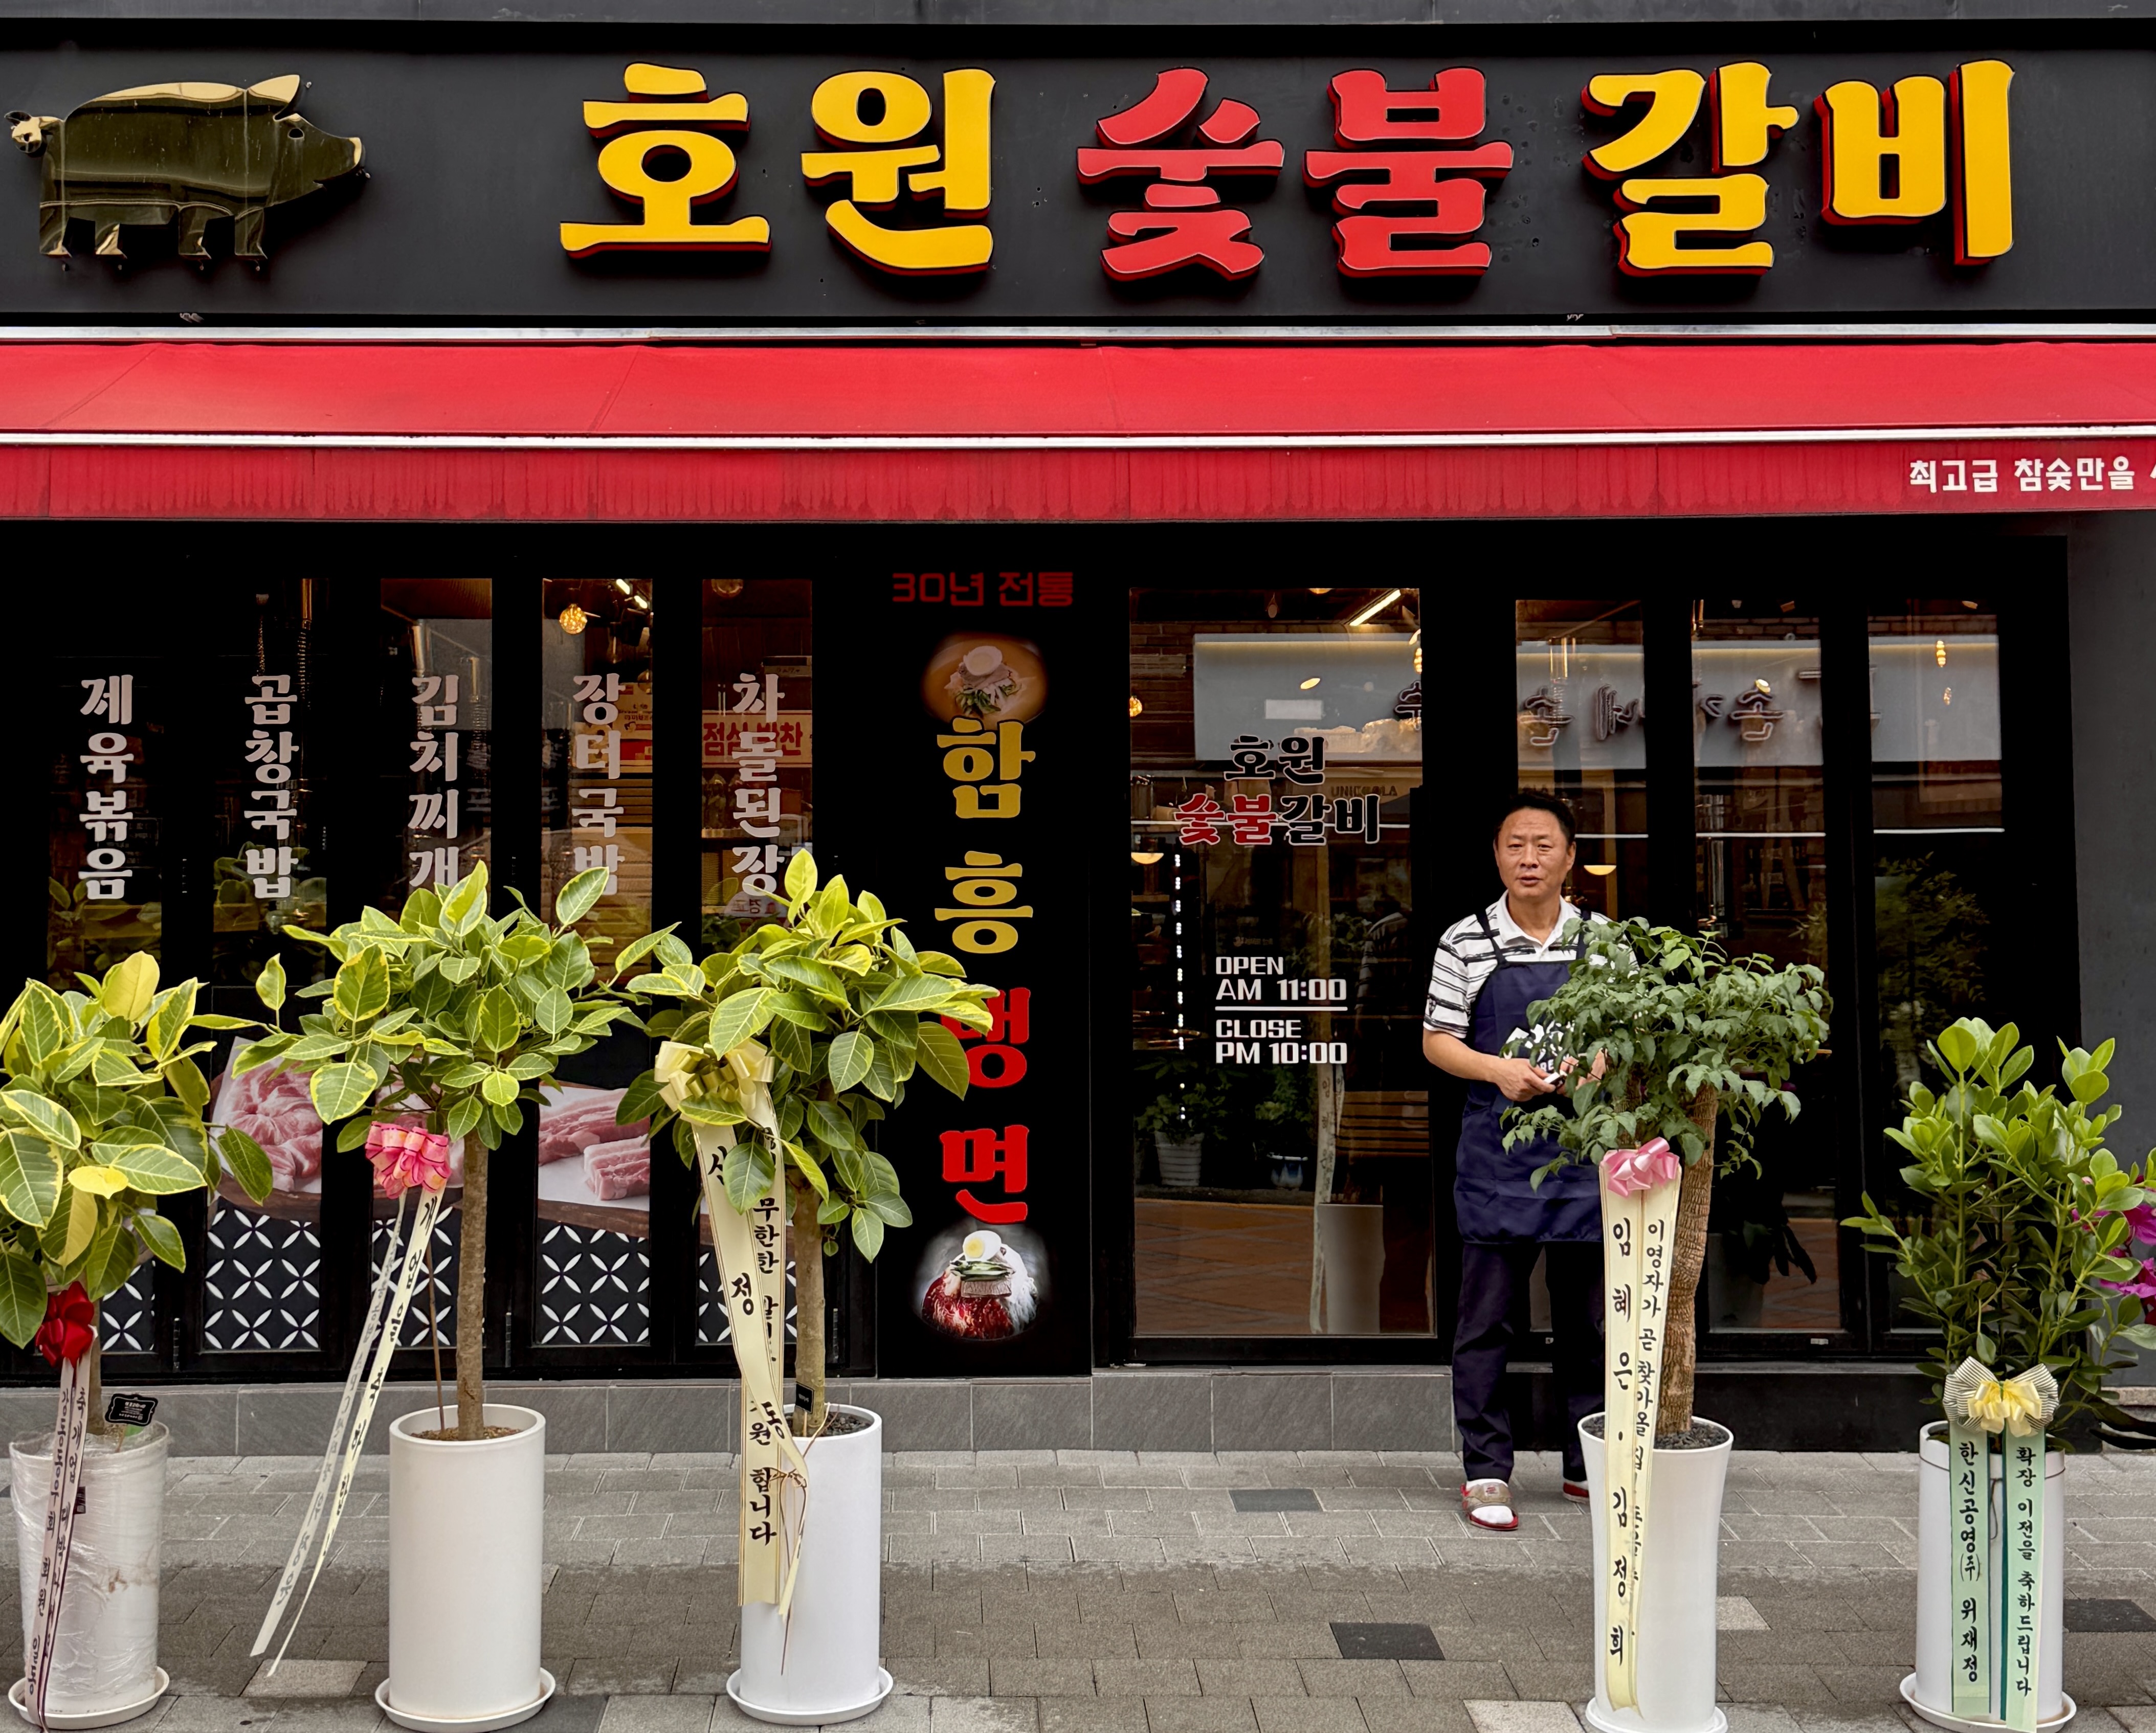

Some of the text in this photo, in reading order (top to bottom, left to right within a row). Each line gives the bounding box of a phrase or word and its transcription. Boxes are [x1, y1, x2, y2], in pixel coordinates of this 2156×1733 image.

[560, 60, 2015, 280] 호원 숯불 갈비
[1909, 459, 1998, 493] 최고급
[2014, 456, 2135, 491] 참숯만을
[892, 572, 1074, 607] 30년 전통
[78, 674, 135, 900] 제육볶음
[244, 674, 300, 899] 곱창국밥
[409, 674, 459, 889] 김치찌개
[731, 673, 786, 897] 차돌된장
[1223, 734, 1326, 786] 호원
[1174, 793, 1381, 847] 숯불갈비
[1215, 956, 1283, 975] OPEN
[1215, 978, 1347, 1000] AM 11:00
[1215, 1019, 1302, 1038] CLOSE
[1215, 1042, 1348, 1064] PM 10:00
[753, 1197, 780, 1274] 무한한
[1642, 1219, 1664, 1319] 이영자가
[1639, 1328, 1657, 1352] 곧
[1636, 1360, 1656, 1437] 찾아올
[749, 1400, 777, 1546] 원 합니다
[2016, 1446, 2037, 1697] 확장 이전을 축하드립니다
[1961, 1597, 1978, 1682] 위재정
